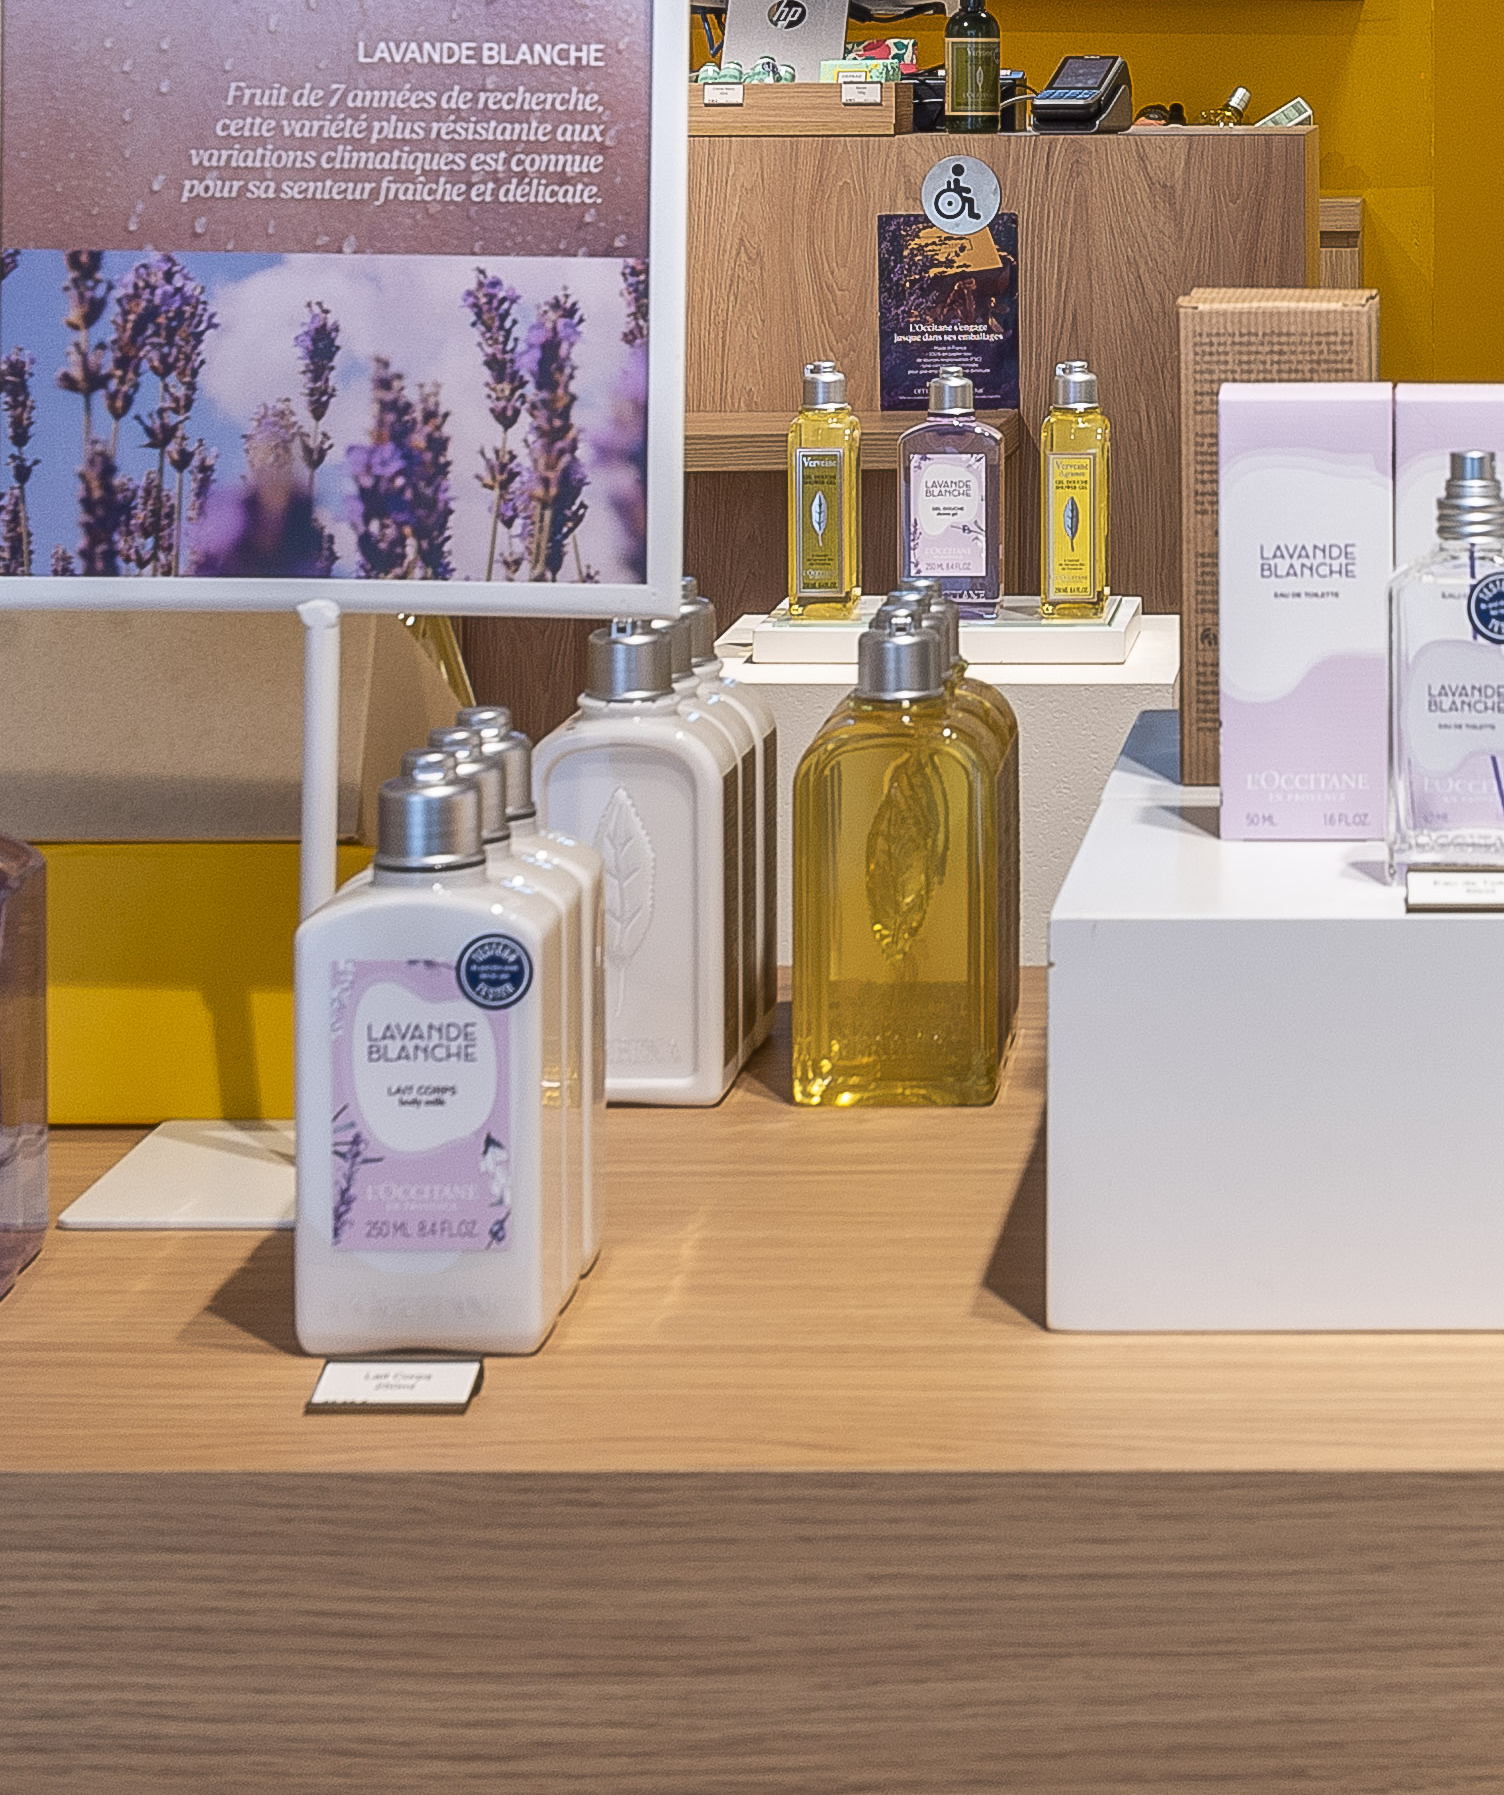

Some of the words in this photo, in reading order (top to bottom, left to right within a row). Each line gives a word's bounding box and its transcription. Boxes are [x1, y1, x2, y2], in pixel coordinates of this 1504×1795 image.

[358, 41, 477, 65] LAVANDE
[482, 43, 606, 67] BLANCHE
[226, 82, 287, 106] Fruit
[292, 82, 324, 107] de
[329, 84, 346, 107] 7
[346, 84, 437, 109] années
[441, 85, 473, 109] de
[477, 86, 604, 113] recherche,
[216, 116, 276, 137] cette
[281, 114, 367, 138] variété
[370, 115, 426, 144] plus
[429, 115, 552, 141] résistante
[556, 124, 605, 142] aux
[189, 144, 317, 168] variations
[321, 145, 466, 175] climatiques
[470, 150, 508, 171] est
[510, 154, 604, 173] connue
[180, 178, 244, 202] pour
[246, 180, 276, 198] sa
[279, 179, 376, 200] senteur
[374, 176, 466, 205] fraîche
[470, 181, 496, 201] et
[498, 177, 603, 204] délicate.
[1258, 543, 1357, 561] LAVANDE
[1258, 562, 1357, 579] BLANCHE
[366, 1021, 478, 1043] LAVANDE
[366, 1042, 478, 1064] BLANCHE
